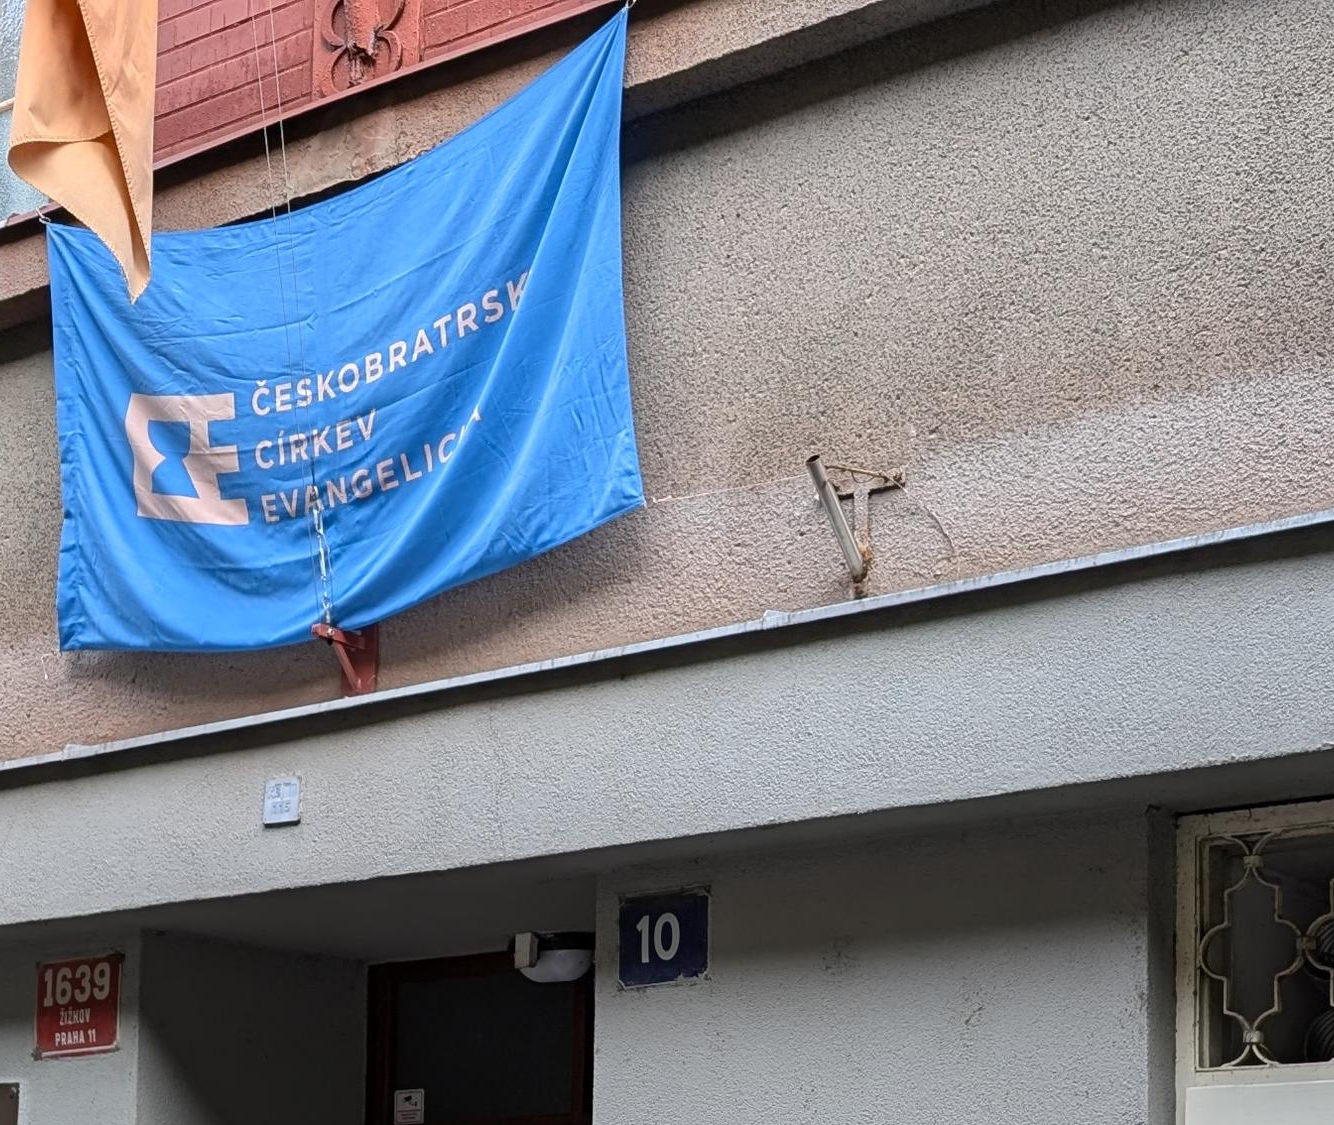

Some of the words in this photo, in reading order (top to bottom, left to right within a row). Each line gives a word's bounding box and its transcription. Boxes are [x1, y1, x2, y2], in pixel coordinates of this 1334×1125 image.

[254, 408, 378, 470] CÍRKEV
[635, 911, 681, 964] 10
[42, 961, 111, 1008] 1639
[54, 1030, 85, 1047] PRAHA
[87, 1028, 97, 1044] 11
[58, 1006, 92, 1026] ŽIŽKOV
